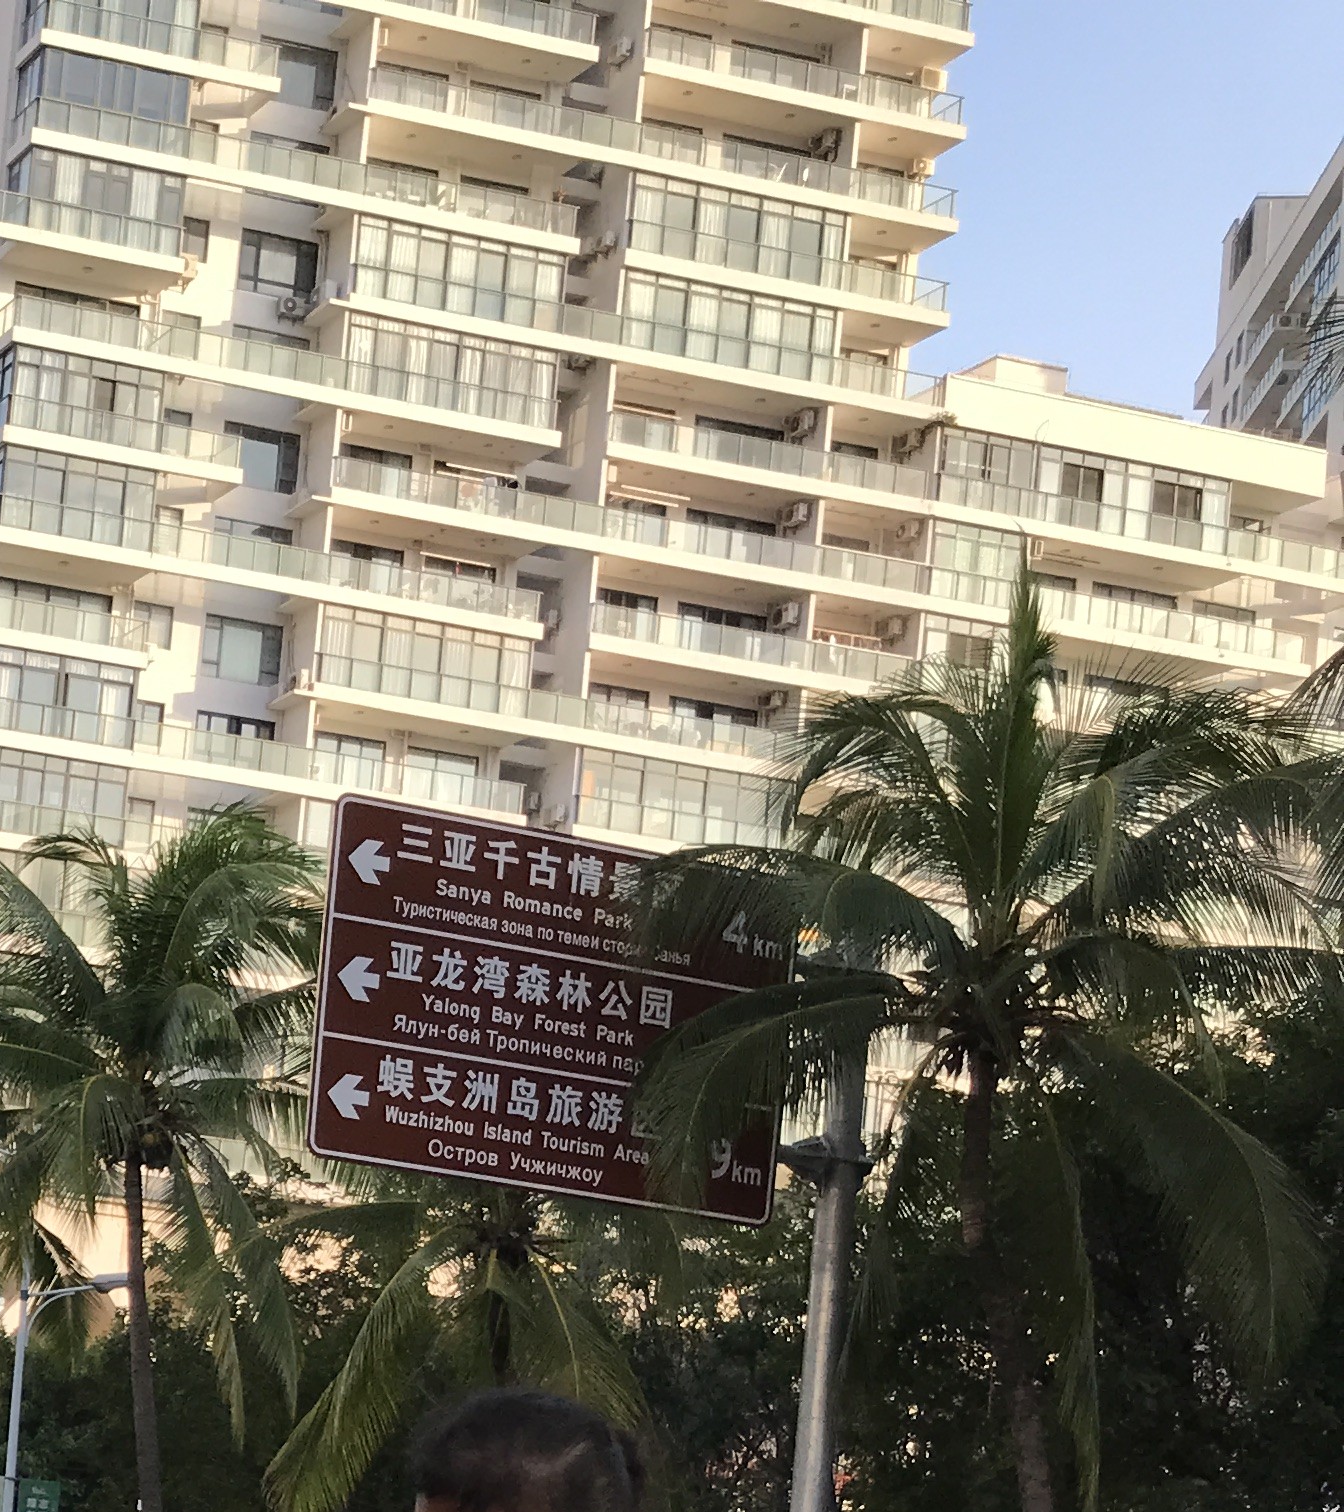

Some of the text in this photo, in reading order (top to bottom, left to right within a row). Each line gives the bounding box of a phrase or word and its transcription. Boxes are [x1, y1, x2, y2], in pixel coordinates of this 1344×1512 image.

[393, 895, 497, 930] Туристическая
[501, 919, 533, 938] зона
[537, 927, 554, 941] по
[436, 878, 634, 932] Sanya Romance Park
[722, 911, 748, 954] 4
[386, 940, 673, 1029] 亚龙湾森林公园
[393, 1014, 646, 1077] Ялун-бей Тропический пар
[421, 993, 635, 1047] Yalong Bay Forest Park
[377, 1054, 662, 1140] 蜈支洲岛旅游
[385, 1105, 650, 1165] Wuzhizhou Island Tourism Area
[428, 1138, 603, 1187] Остров Учжичжоу
[732, 1160, 761, 1186] km
